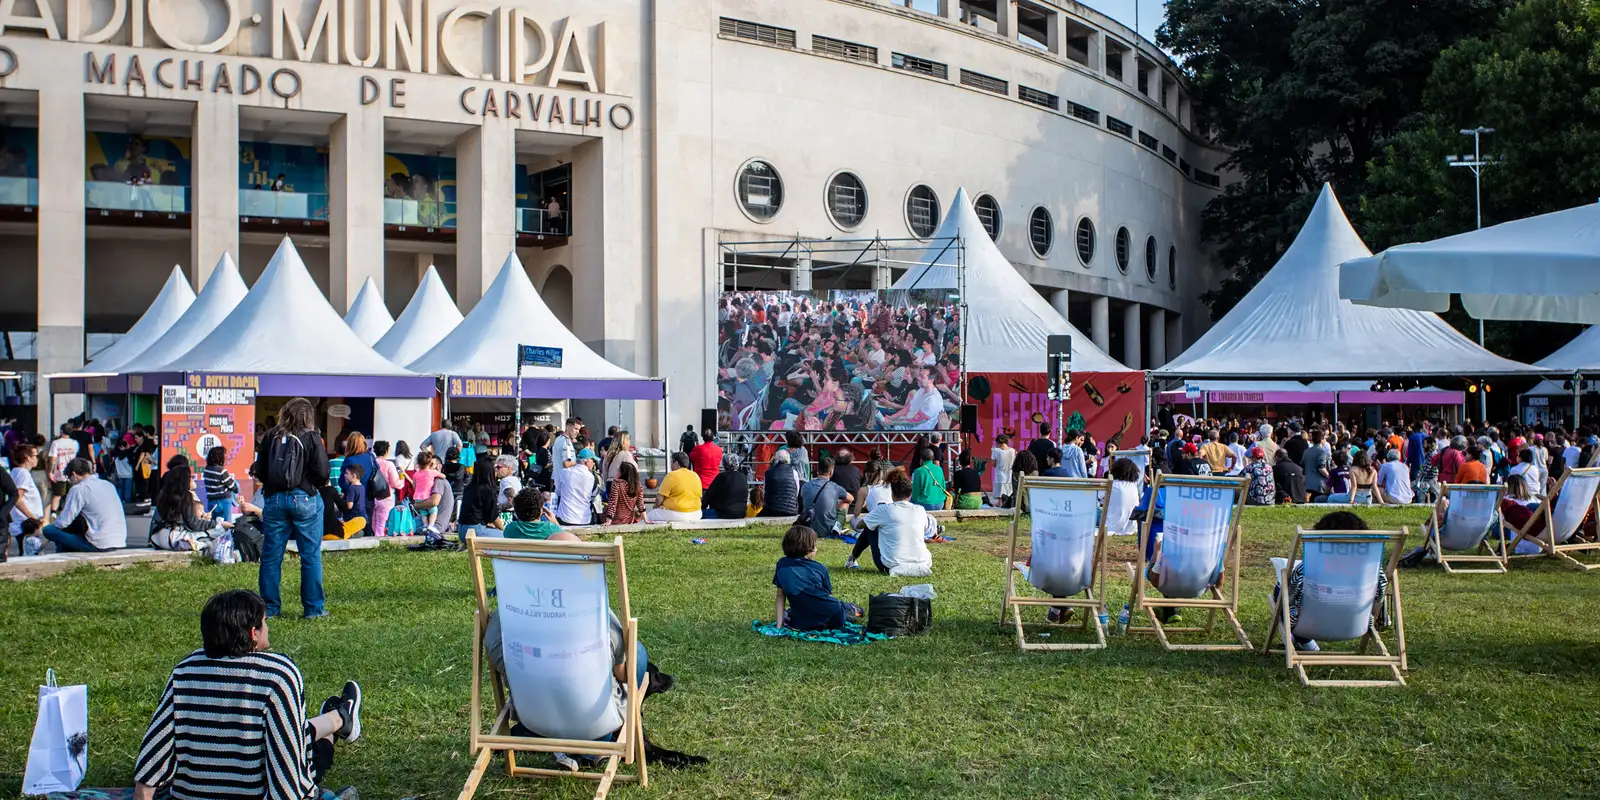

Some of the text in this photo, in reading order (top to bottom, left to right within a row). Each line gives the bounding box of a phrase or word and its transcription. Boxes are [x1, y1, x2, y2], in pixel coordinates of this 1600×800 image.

[86, 51, 302, 98] MACHADO
[361, 75, 406, 108] DE
[461, 86, 634, 130] CARVALHO
[465, 379, 497, 396] EDITORA
